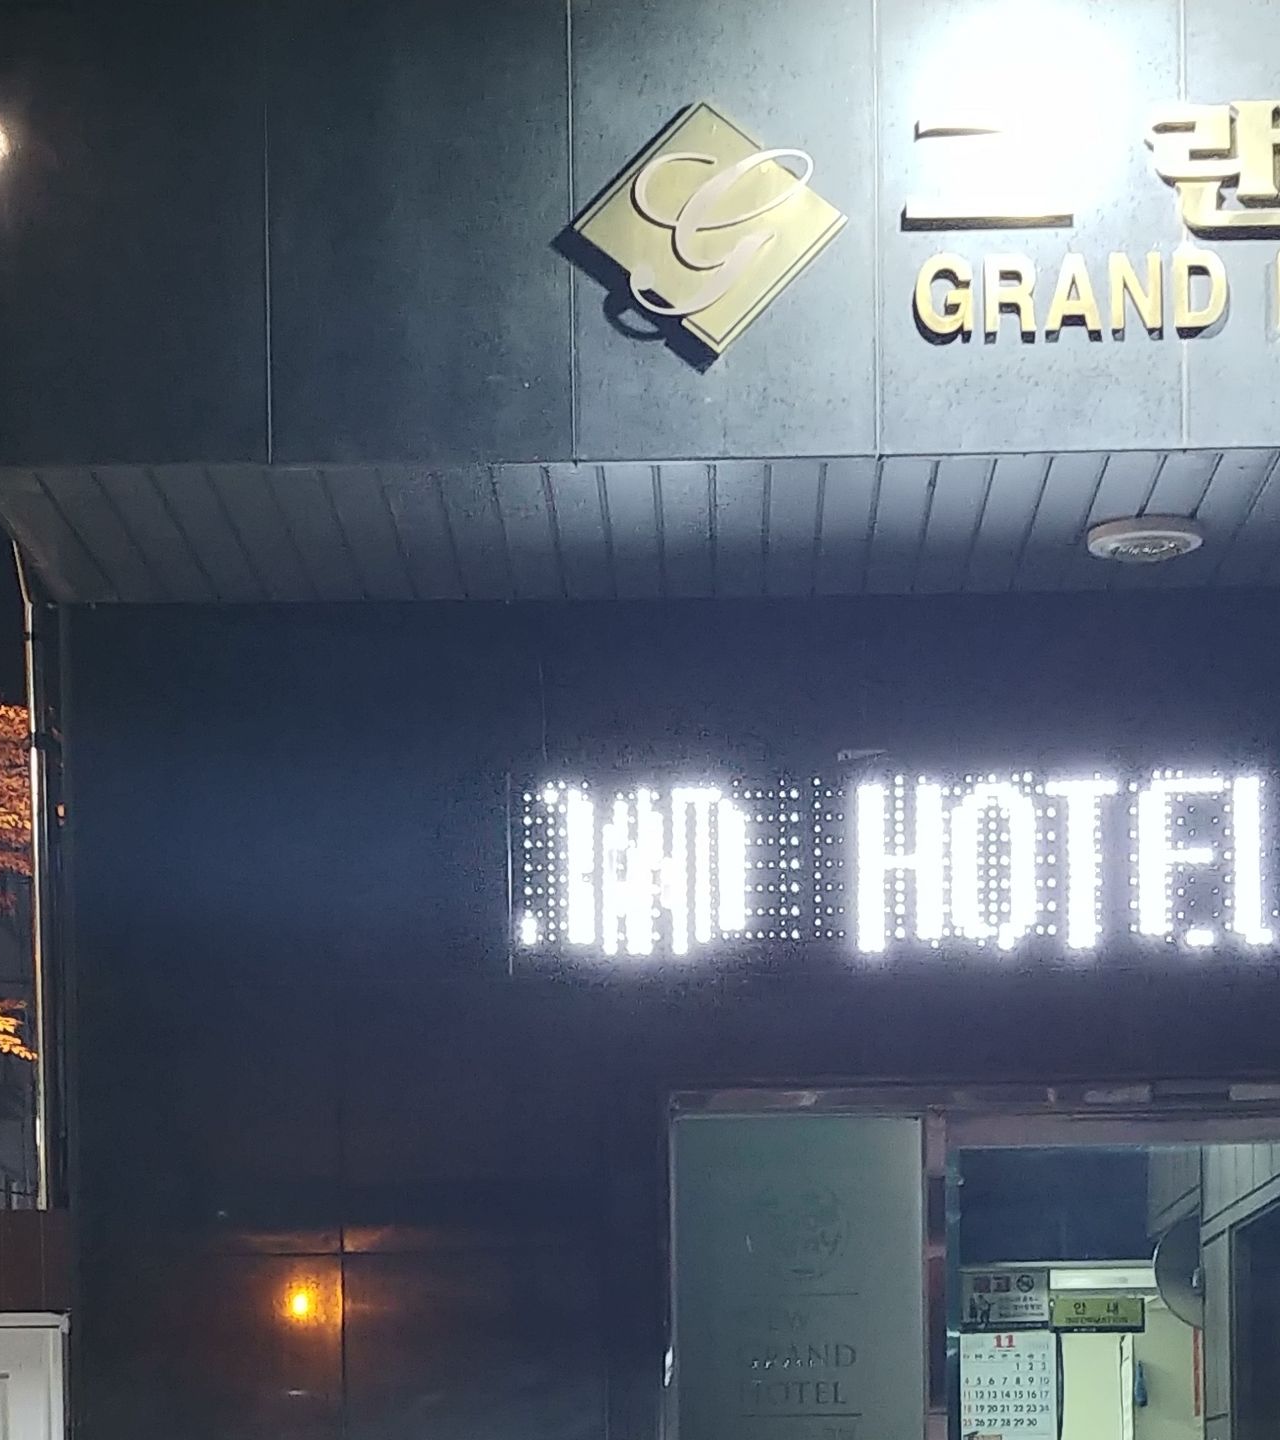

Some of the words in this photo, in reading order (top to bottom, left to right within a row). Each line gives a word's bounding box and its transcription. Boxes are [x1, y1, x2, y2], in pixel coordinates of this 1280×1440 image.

[914, 248, 1231, 340] GRAND
[993, 1334, 1016, 1348] 11
[975, 1390, 984, 1399] 12
[987, 1390, 997, 1399] 13
[1001, 1390, 1011, 1399] 14
[1014, 1390, 1024, 1399] 15
[1027, 1390, 1037, 1399] 16
[975, 1404, 985, 1413] 19
[987, 1404, 998, 1413] 20
[1000, 1404, 1010, 1413] 21
[1013, 1404, 1024, 1413] 22
[1026, 1404, 1037, 1413] 23
[975, 1418, 985, 1427] 26
[987, 1418, 998, 1427] 27
[1000, 1418, 1011, 1427] 28
[1013, 1418, 1024, 1427] 29
[1026, 1418, 1038, 1427] 30
